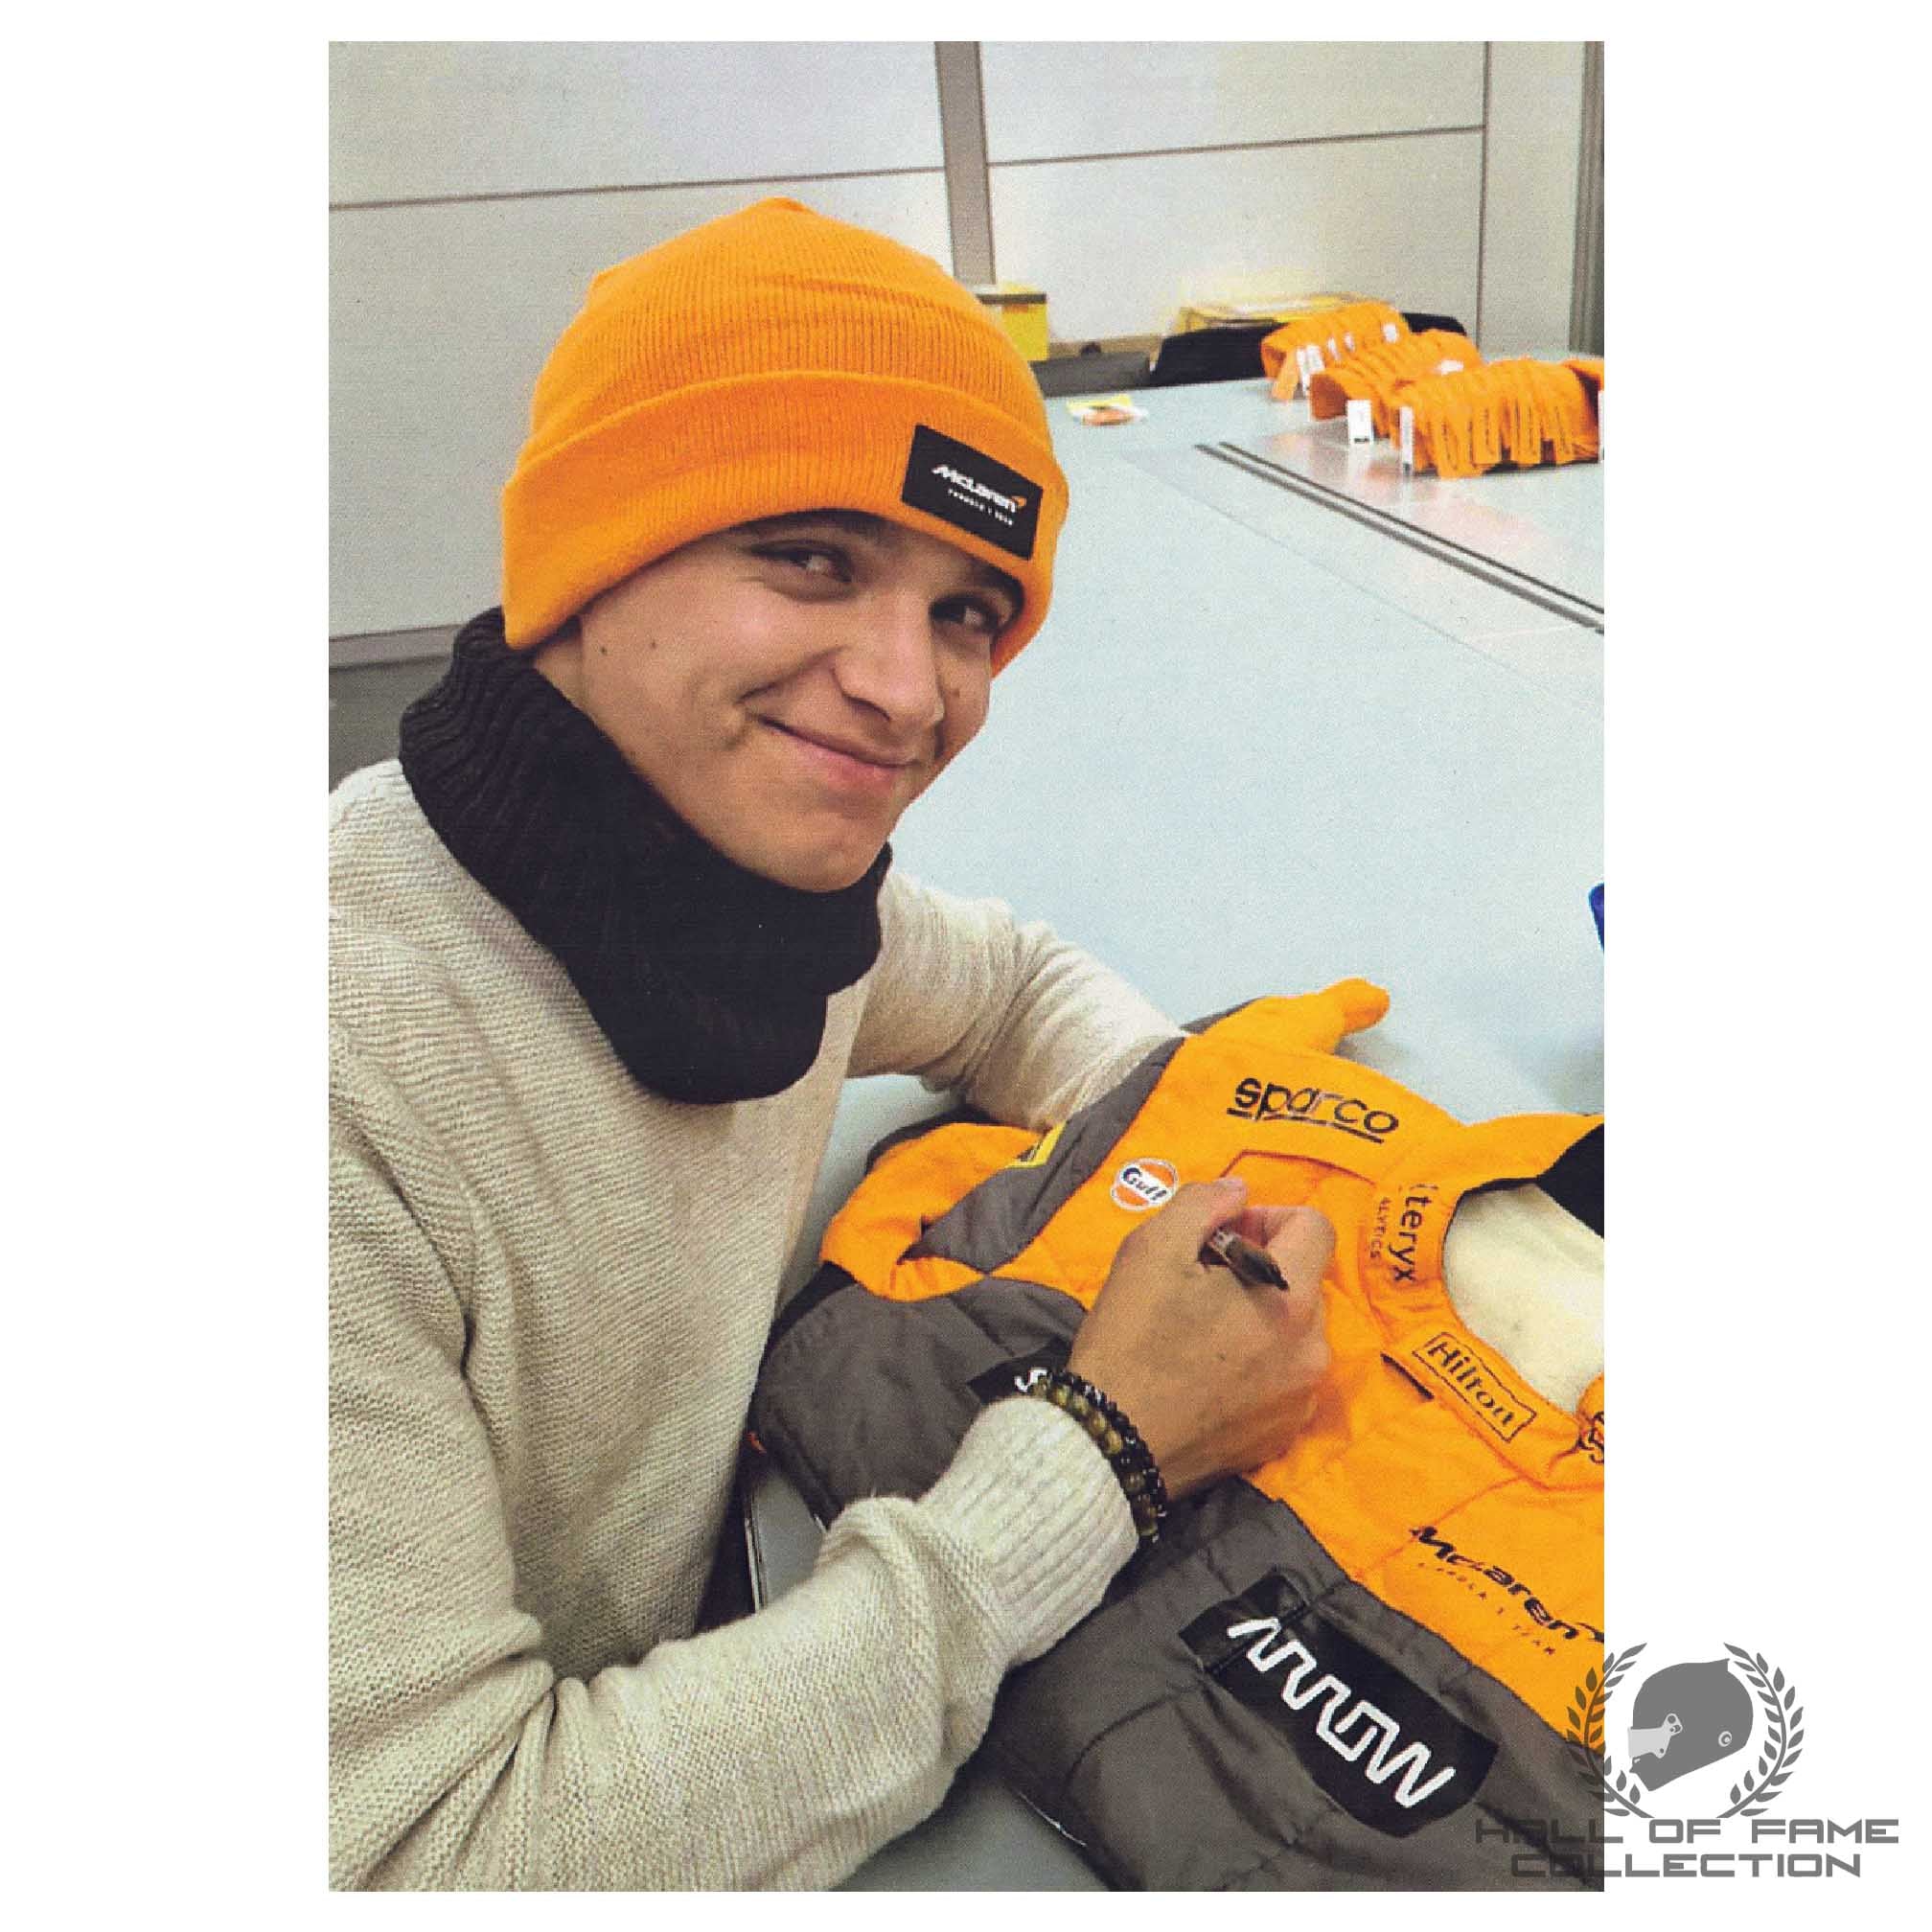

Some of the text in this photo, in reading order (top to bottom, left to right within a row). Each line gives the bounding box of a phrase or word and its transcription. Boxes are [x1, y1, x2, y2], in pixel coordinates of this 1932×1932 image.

[1234, 1077, 1399, 1135] sparco
[1122, 1166, 1167, 1201] Gulf
[1427, 1342, 1514, 1426] Hilton
